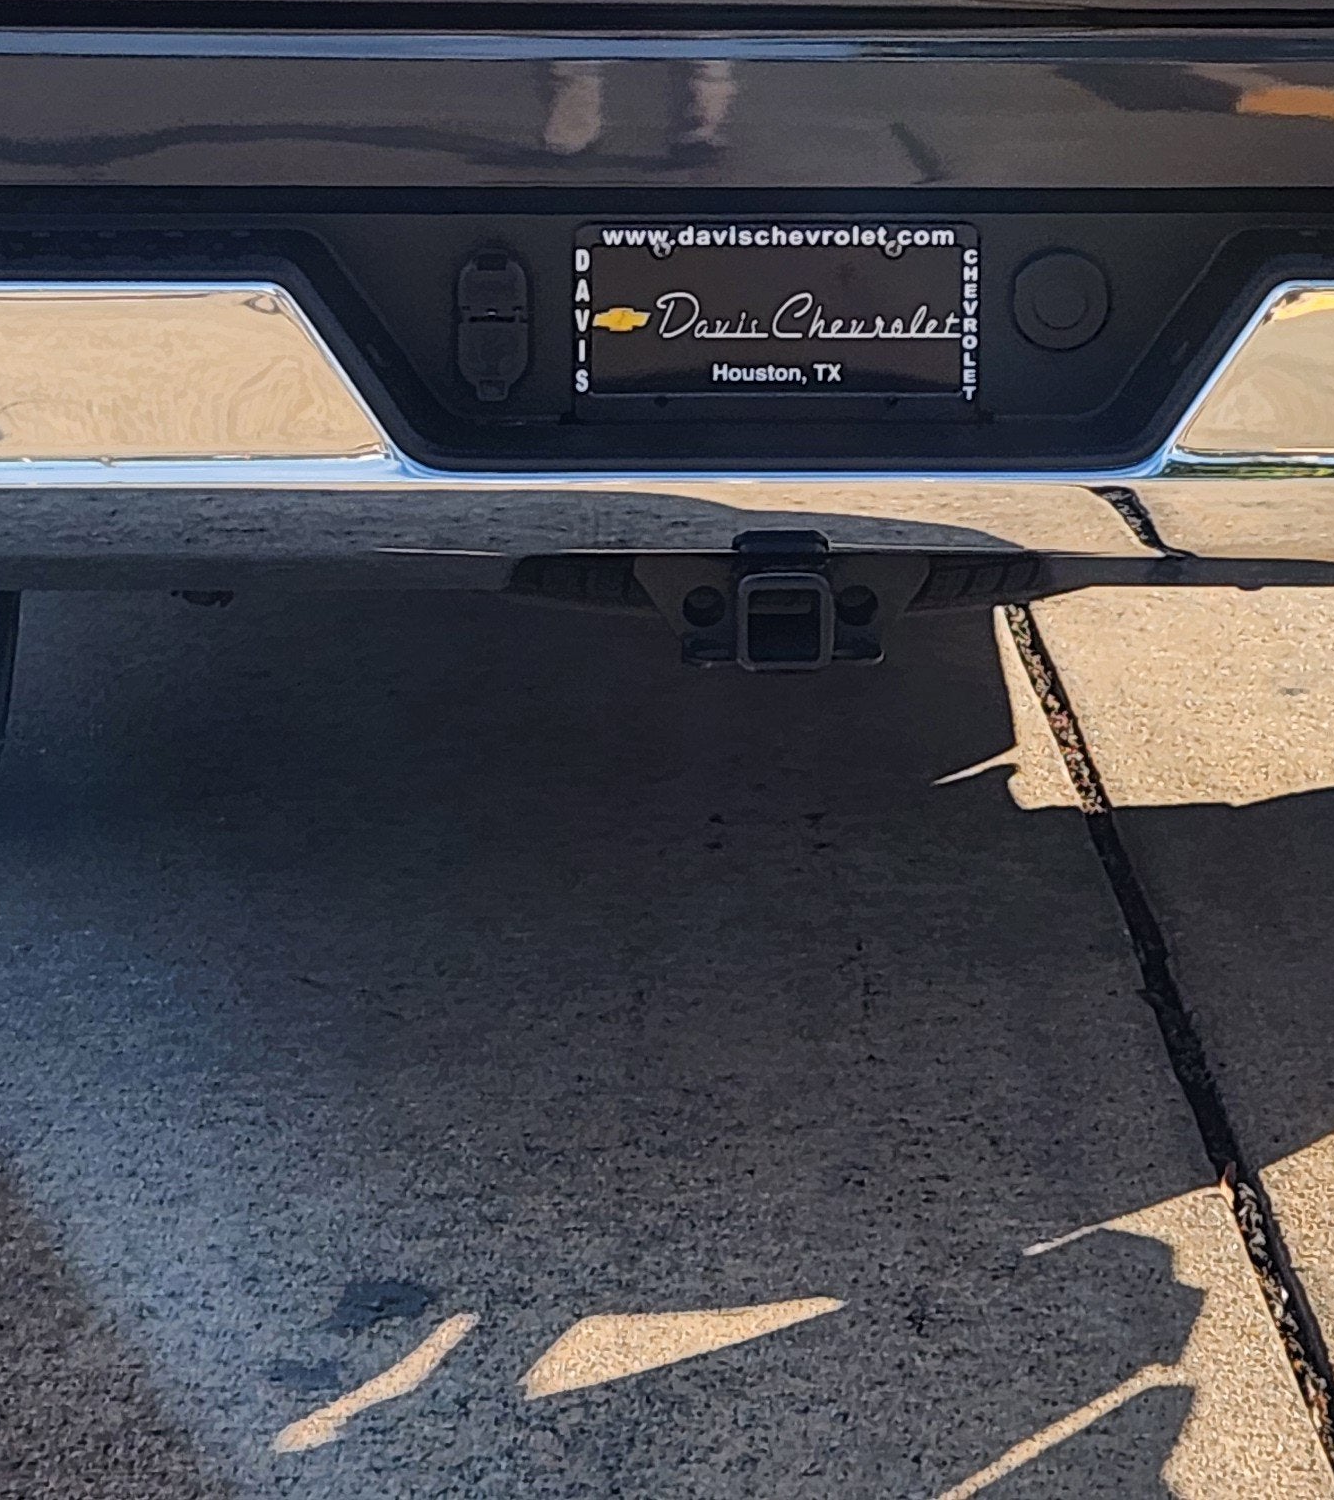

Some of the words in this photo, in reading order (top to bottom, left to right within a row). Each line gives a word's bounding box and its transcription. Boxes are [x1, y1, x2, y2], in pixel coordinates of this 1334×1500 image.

[602, 225, 955, 246] www.davischevroletcom
[574, 248, 591, 393] DAVIS
[655, 291, 769, 339] Davis
[771, 291, 962, 339] Chevrolet
[961, 248, 980, 401] CHEVROLET
[712, 363, 807, 386] Houston,
[813, 363, 842, 383] TX
